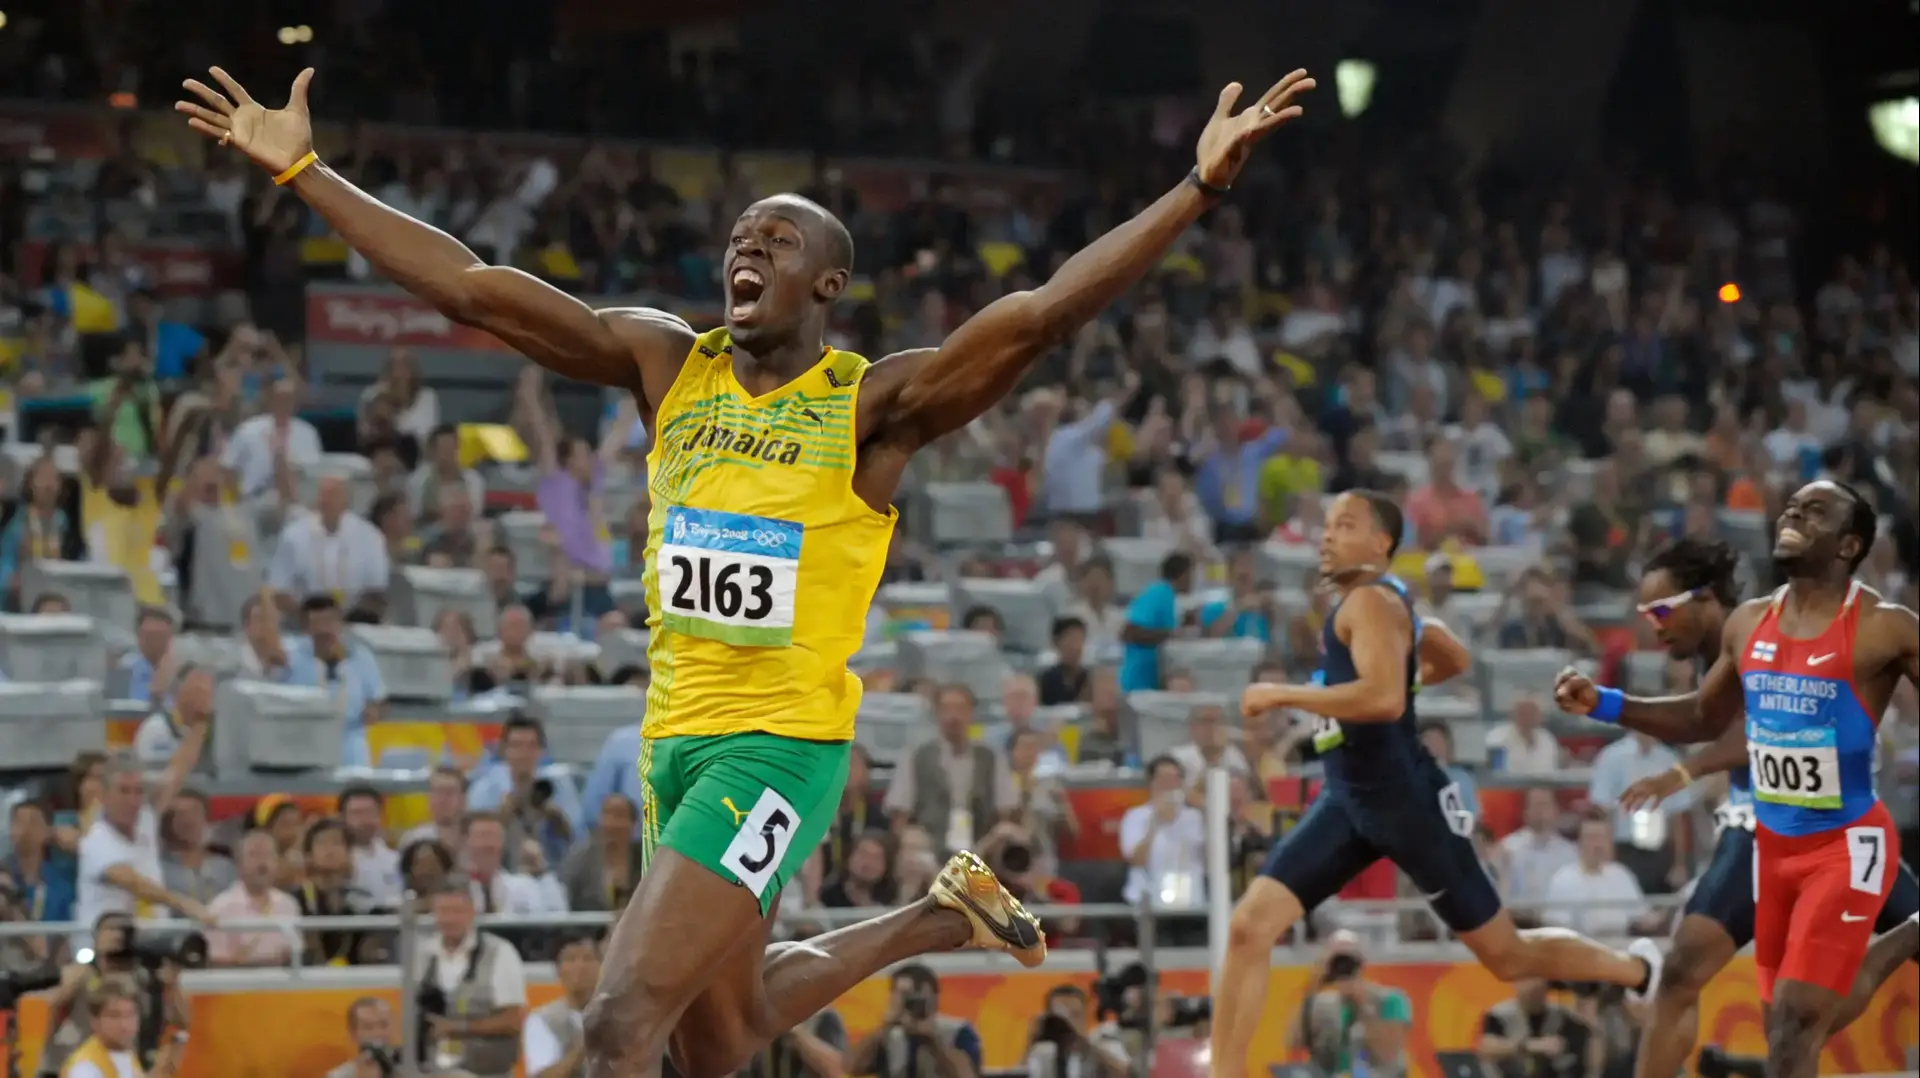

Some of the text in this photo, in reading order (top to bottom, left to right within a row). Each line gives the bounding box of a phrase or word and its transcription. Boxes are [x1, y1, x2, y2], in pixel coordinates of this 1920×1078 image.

[671, 555, 773, 620] 2163
[1759, 693, 1818, 715] ANTILLES
[1754, 749, 1822, 792] 1003
[738, 808, 790, 874] 5
[1858, 834, 1878, 883] 7
